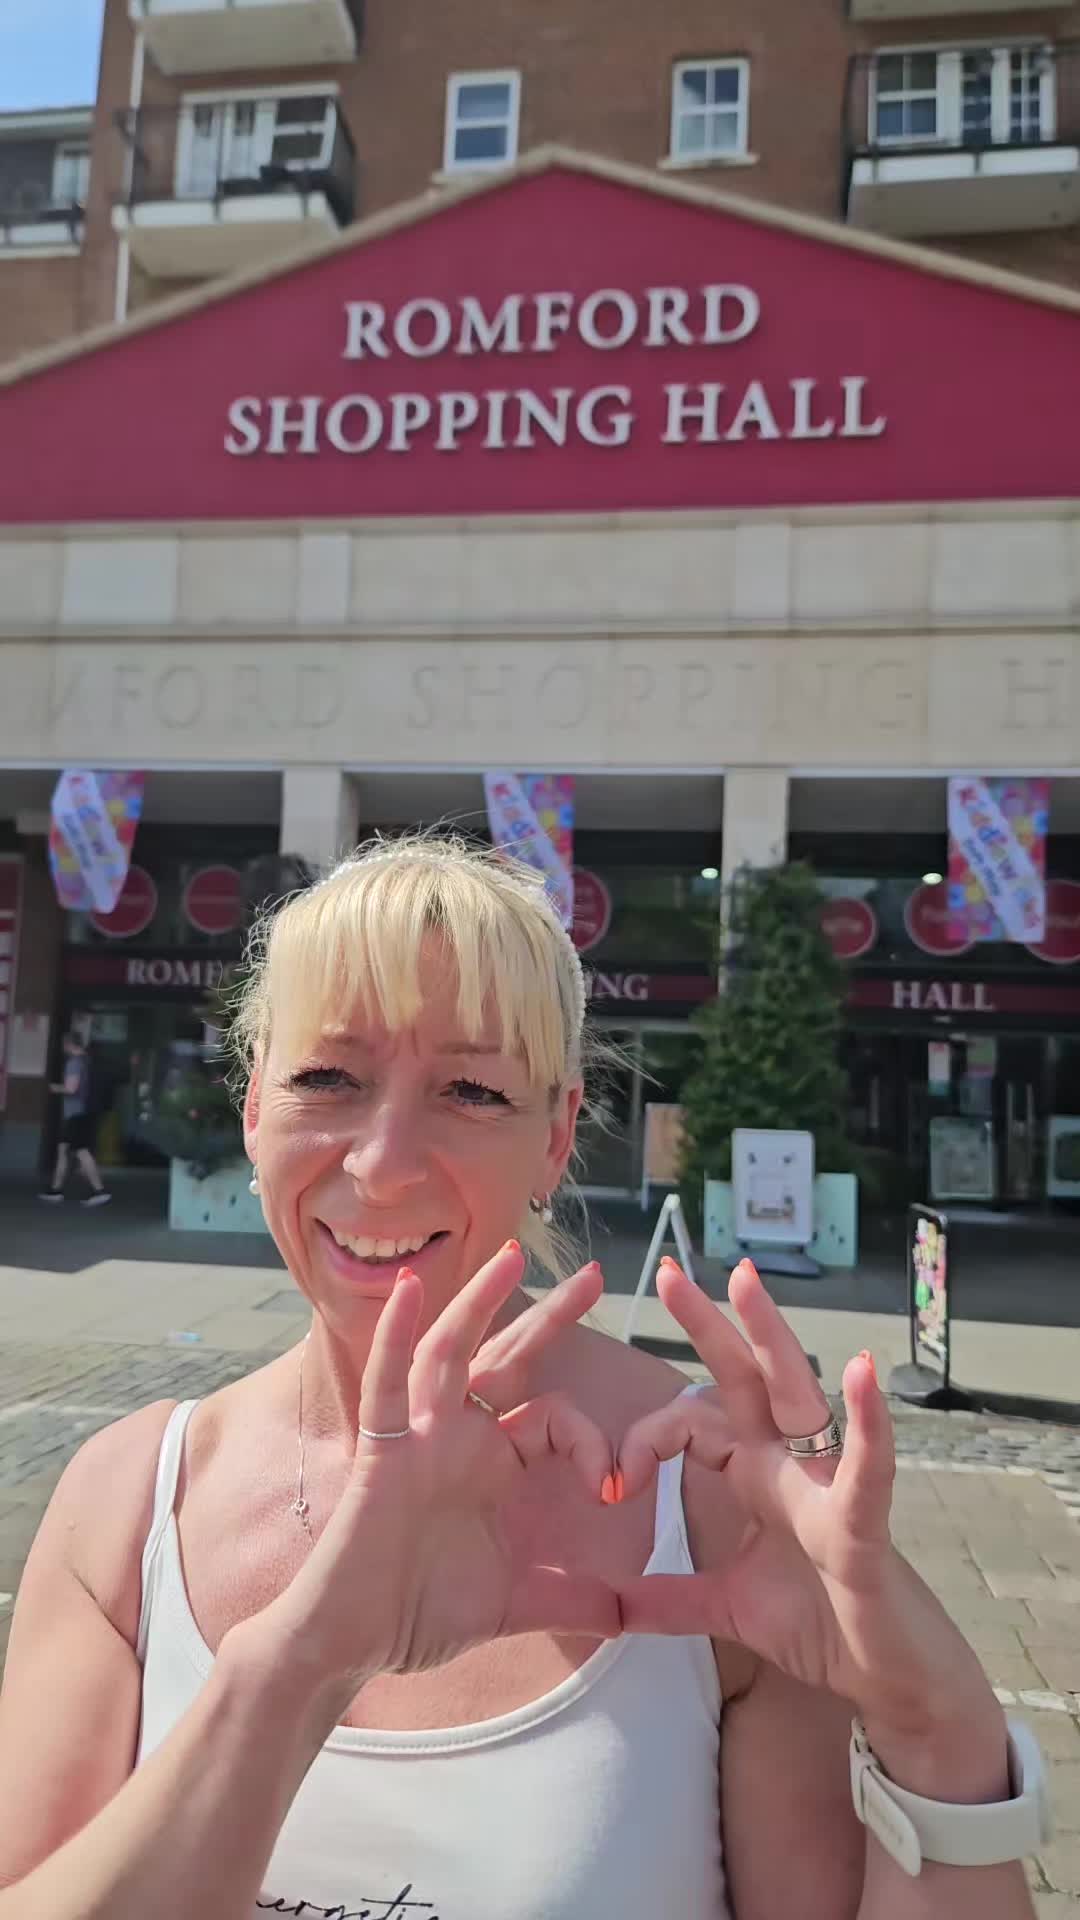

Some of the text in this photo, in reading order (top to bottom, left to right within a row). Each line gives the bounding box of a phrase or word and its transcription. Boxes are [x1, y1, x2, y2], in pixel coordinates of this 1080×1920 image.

[342, 283, 761, 360] ROMFORD
[224, 375, 887, 456] SHOPPING HALL
[407, 659, 914, 730] SHOPPING
[126, 958, 997, 1011] ROMF ING HALL
